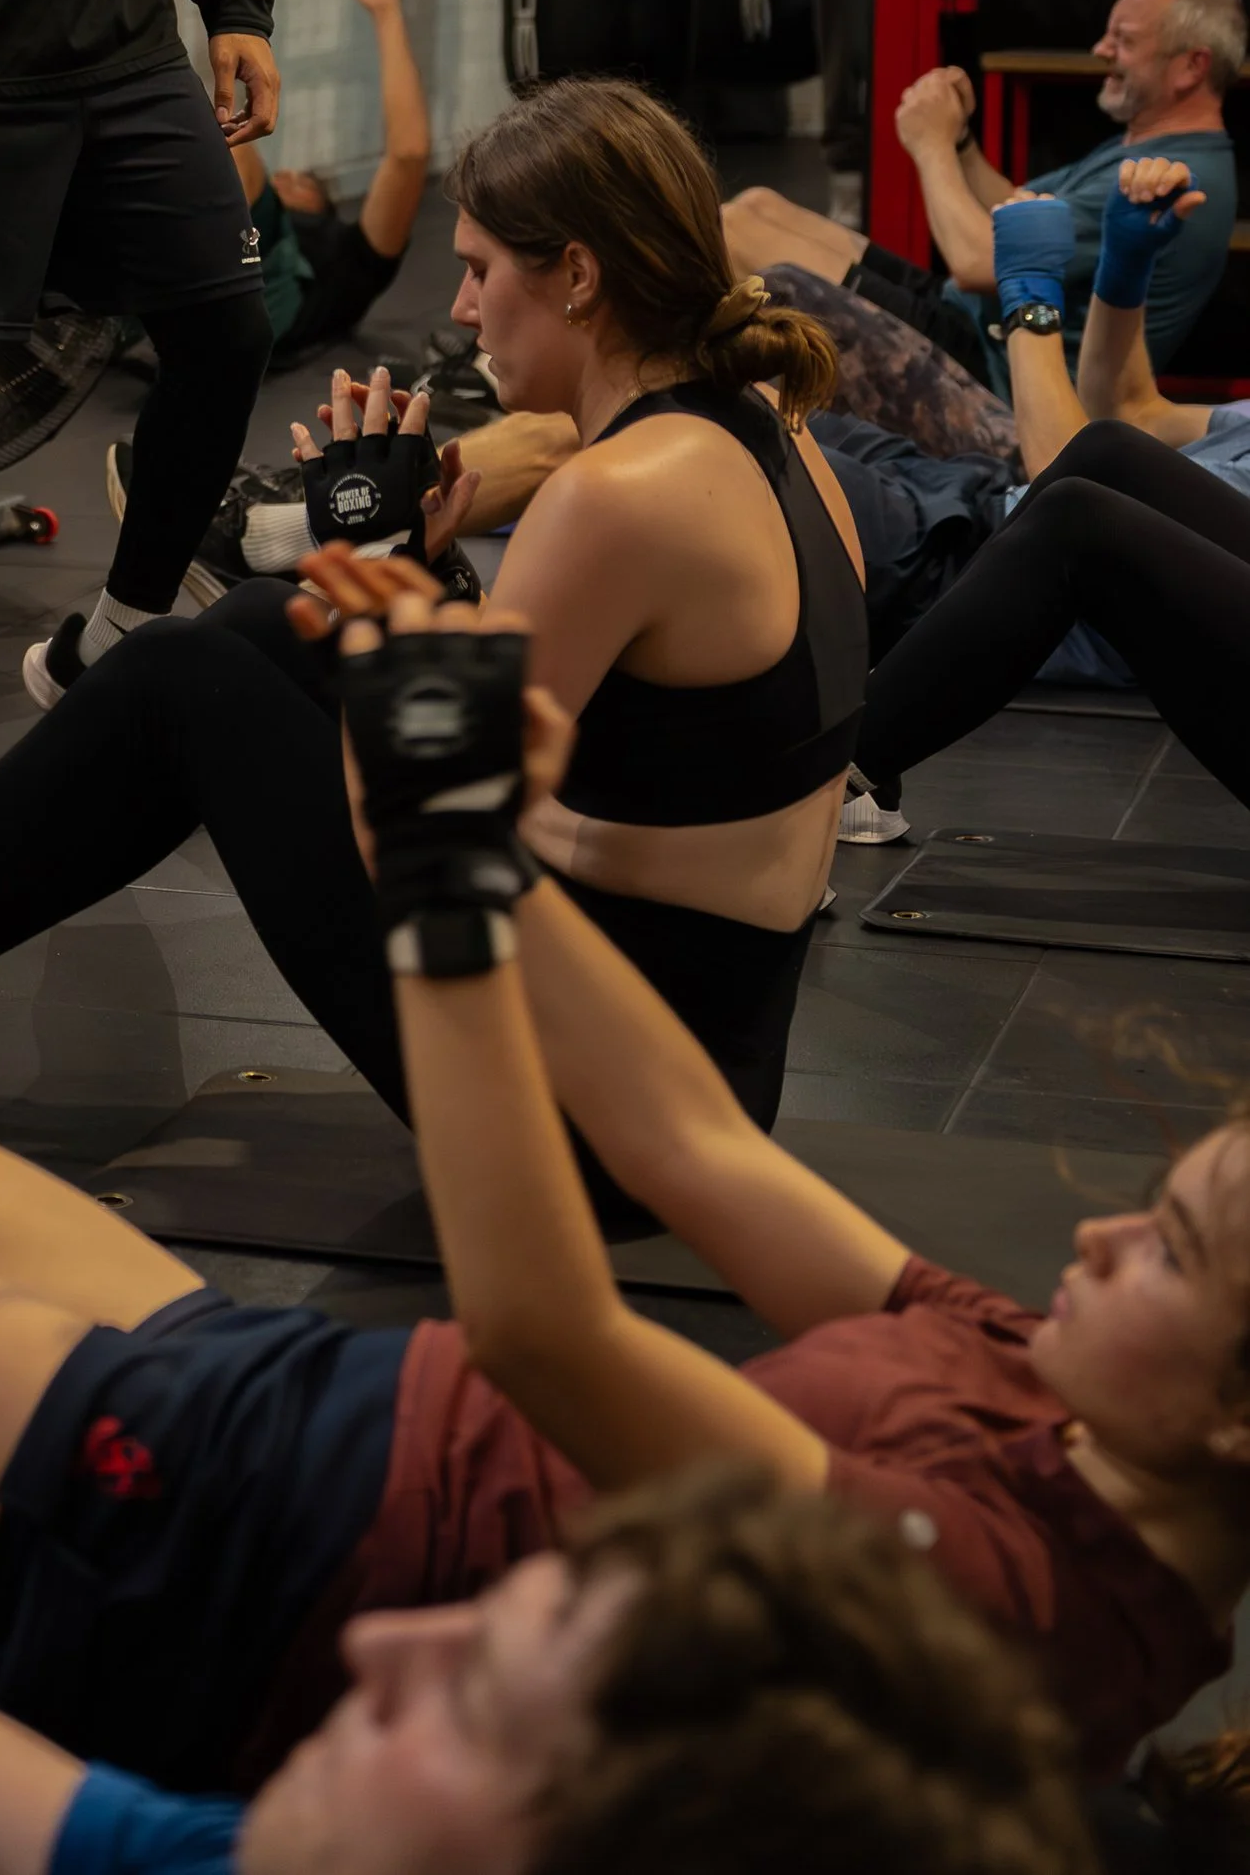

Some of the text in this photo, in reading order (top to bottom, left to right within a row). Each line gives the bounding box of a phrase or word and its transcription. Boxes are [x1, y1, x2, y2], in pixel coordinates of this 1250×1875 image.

[336, 488, 360, 502] POWER
[360, 486, 370, 497] OF
[337, 494, 372, 514] BOXING
